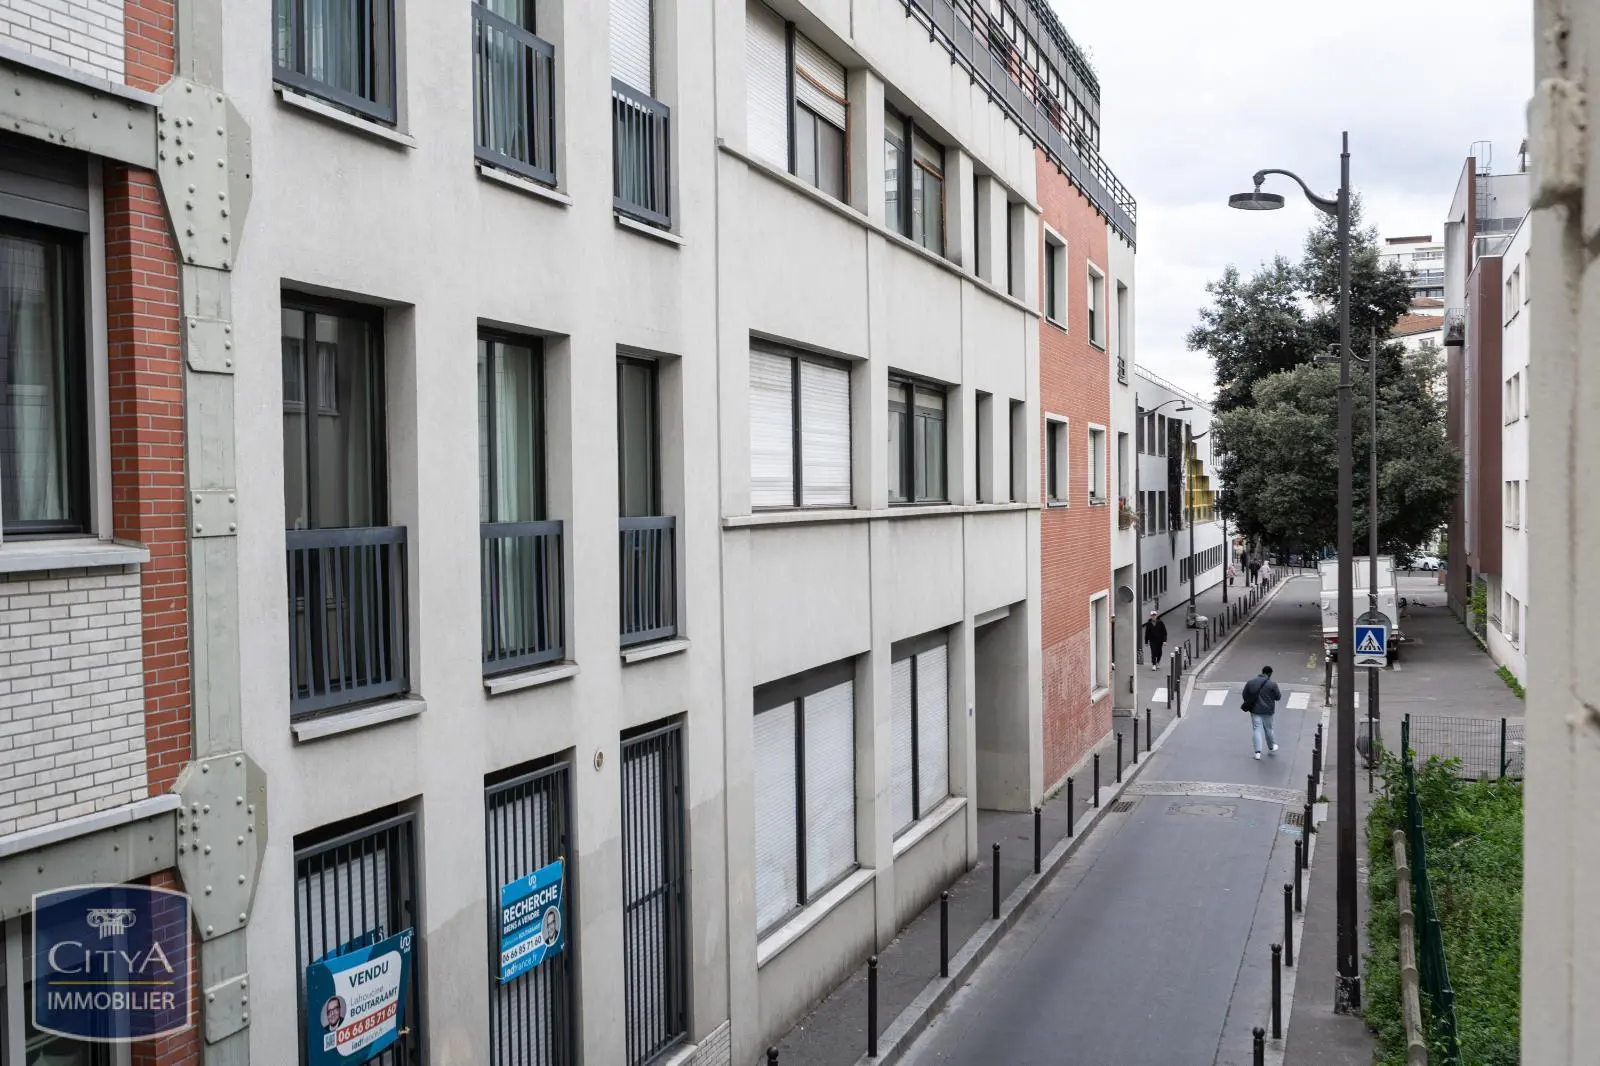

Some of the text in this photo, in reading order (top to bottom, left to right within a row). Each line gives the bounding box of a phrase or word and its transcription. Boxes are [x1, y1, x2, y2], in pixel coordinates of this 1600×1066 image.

[504, 885, 558, 924] RECHERCHE
[504, 921, 518, 935] BIENS
[521, 910, 541, 925] VENDRE
[503, 953, 510, 964] 06
[510, 949, 518, 958] 66
[519, 944, 526, 954] 85
[527, 940, 534, 950] 71
[535, 935, 542, 946] 60
[349, 960, 389, 988] VENDU
[338, 1003, 396, 1043] 06 66 85 71 60
